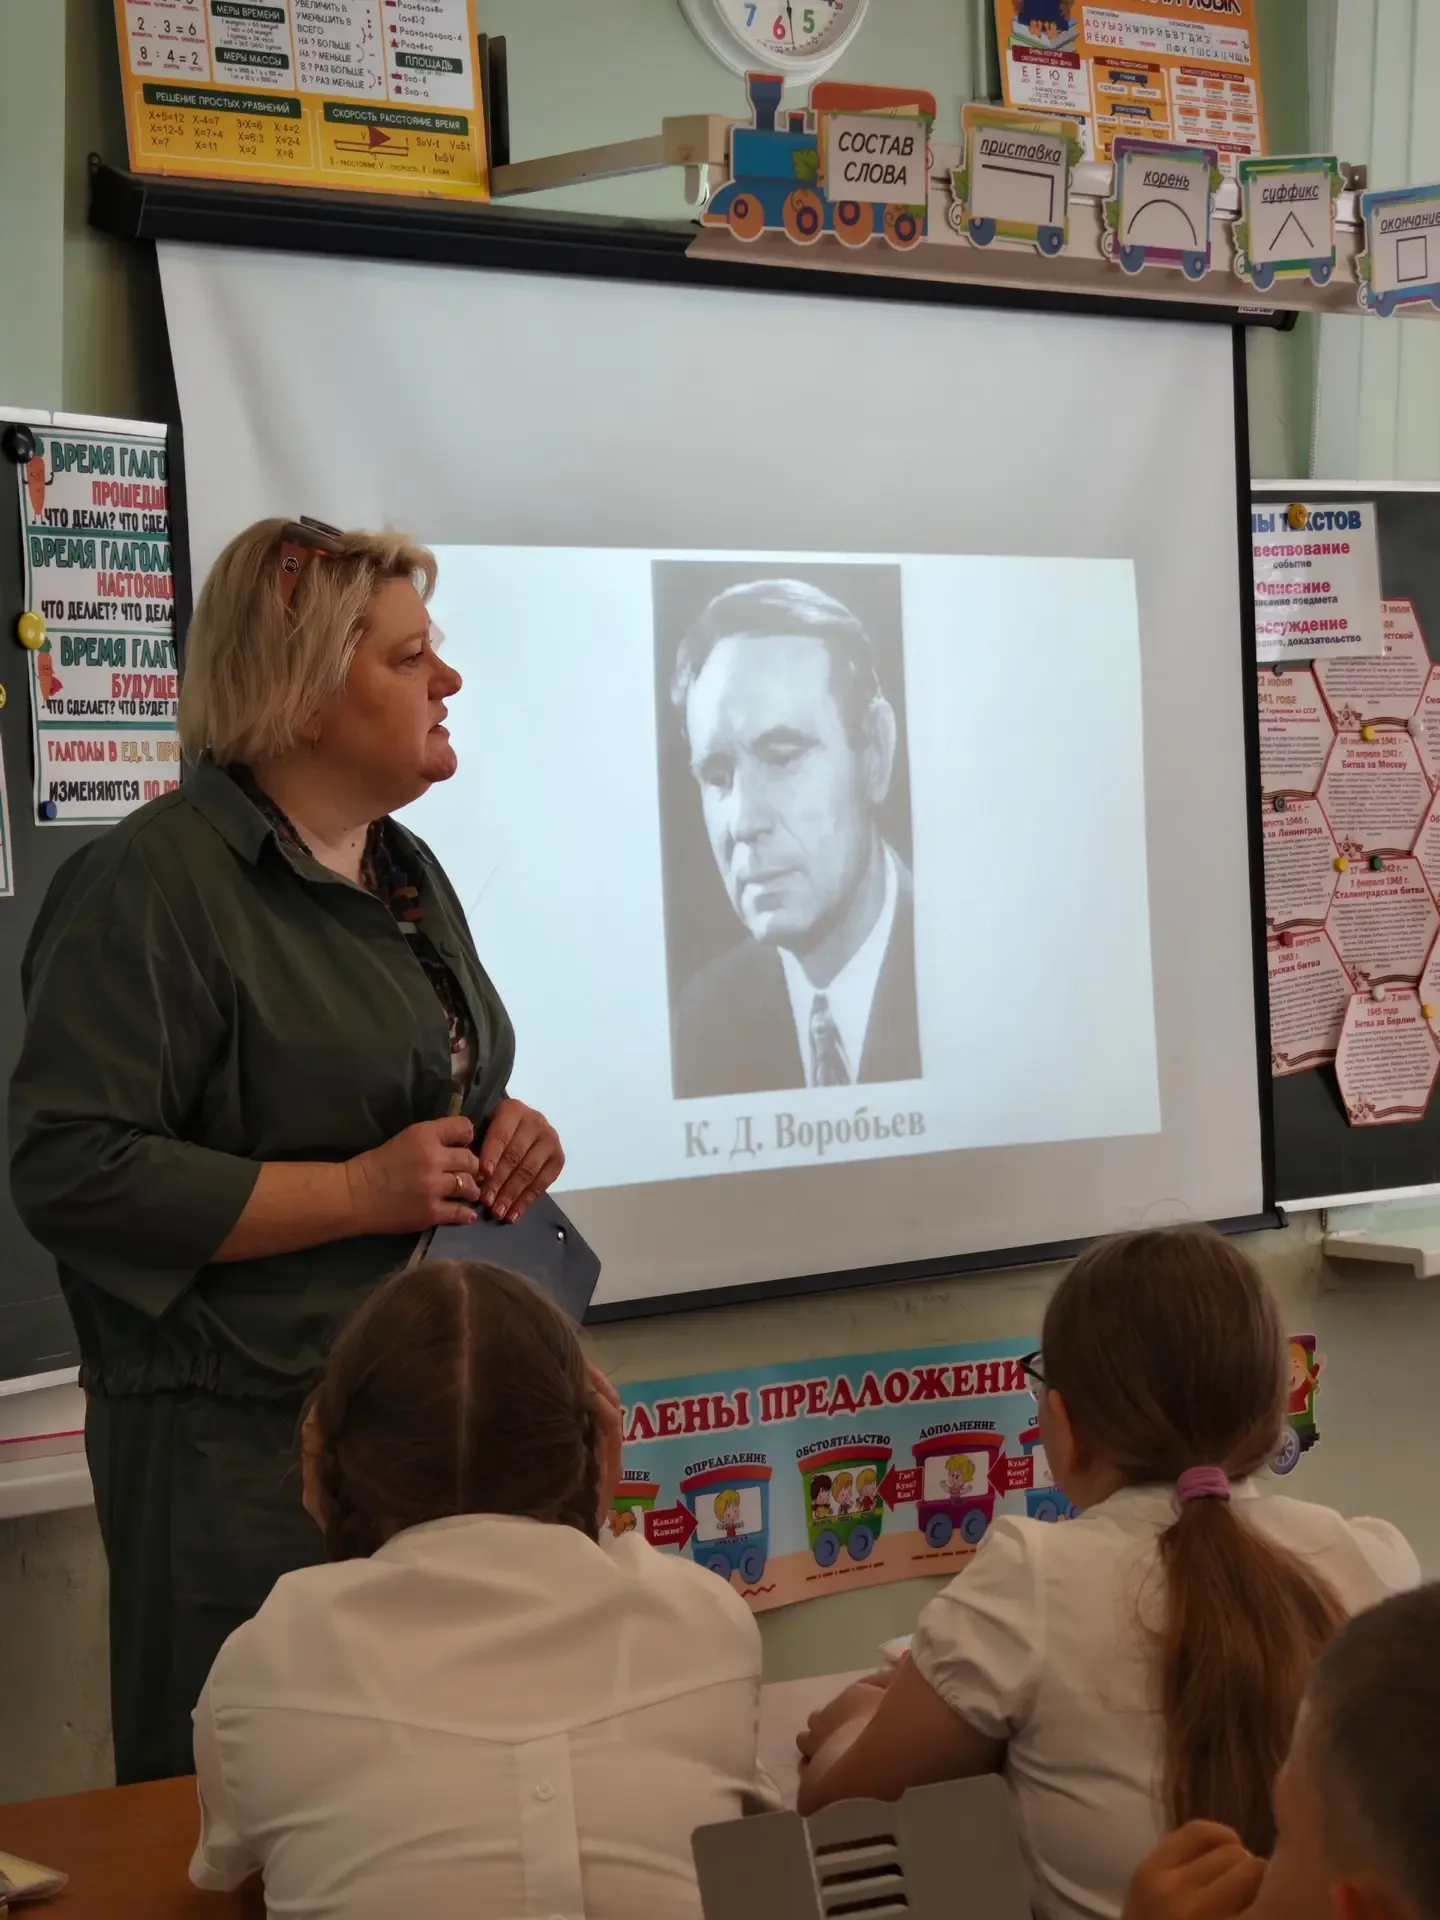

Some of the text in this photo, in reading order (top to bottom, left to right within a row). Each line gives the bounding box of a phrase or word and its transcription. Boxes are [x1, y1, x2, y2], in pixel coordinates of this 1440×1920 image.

[216, 5, 280, 20] МЕРЫ ВРЕМЕНИ
[296, 0, 339, 12] УВЕЛИЧИТЬ
[296, 12, 344, 25] УМЕНЬШИТЬ
[744, 3, 756, 27] 7
[803, 9, 814, 33] 5
[138, 17, 145, 31] 2
[164, 20, 171, 34] 3
[188, 23, 197, 36] 6
[297, 24, 324, 35] ВСЕГО
[773, 15, 785, 40] 6
[318, 39, 351, 50] БОЛЬШЕ
[140, 46, 148, 60] 8
[167, 50, 175, 63] 4
[192, 52, 199, 65] 2
[224, 52, 282, 66] МЕРЫ МАССЫ
[319, 52, 351, 63] МЕНЬШЕ
[406, 56, 453, 71] ПЛОЩАДЬ
[315, 64, 329, 73] РАЗ
[331, 66, 365, 77] БОЛЬШЕ
[316, 76, 330, 86] РАЗ
[332, 78, 365, 89] МЕНЬШЕ
[156, 92, 290, 113] РЕШЕНИЕ ПРОСТЫХ УРАВНЕНИЙ
[435, 120, 461, 130] ВРЕМЯ
[838, 132, 914, 156] СОСТАВ
[981, 138, 1061, 163] приставка
[844, 162, 907, 186] СЛОВА
[1143, 171, 1190, 188] корень
[1262, 185, 1320, 205] суффикс
[1381, 211, 1440, 231] окончание
[51, 442, 168, 481] ВРЕМЯ ГЛАГО
[44, 508, 69, 527] ЧТО
[72, 510, 115, 529] ДЕЛАЛ?
[119, 513, 139, 531] ЧТО
[1279, 511, 1362, 533] ТКСТОВ
[31, 536, 96, 569] ВРЕМЯ
[1254, 542, 1350, 557] вествование
[1274, 560, 1312, 570] событие
[1257, 581, 1331, 597] Описание
[1292, 595, 1338, 607] предмета
[41, 600, 65, 619] ЧТО
[67, 601, 118, 621] ДЕЛАЕТ?
[122, 603, 142, 622] ЧТО
[1287, 634, 1362, 648] доказательство
[60, 636, 127, 667] ВРЕМЯ
[66, 700, 168, 717] СДЕЛАЕТ? ЧТО БУДЕТ
[48, 741, 104, 762] ГЛАГОЛЫ
[108, 742, 118, 762] В
[1342, 760, 1365, 769] Битва
[1378, 760, 1407, 770] Москву
[50, 781, 140, 801] ИЗМЕНЯЮТСЯ
[1278, 828, 1323, 837] Ленинград
[1334, 886, 1425, 899] Сталинградская битва
[1297, 960, 1321, 970] битва
[1354, 1020, 1375, 1028] Битва
[1386, 1016, 1416, 1026] Берлин
[684, 1106, 926, 1159] К. Д. Воробьев
[919, 1420, 996, 1441] ДОПОЛНЕНИЕ
[796, 1434, 891, 1458] ОБСТОЯТЕЛЬСТВО
[685, 1453, 767, 1476] ОПРЕДЕЛЕНИЕ
[622, 1470, 651, 1482] ЩЕЕ
